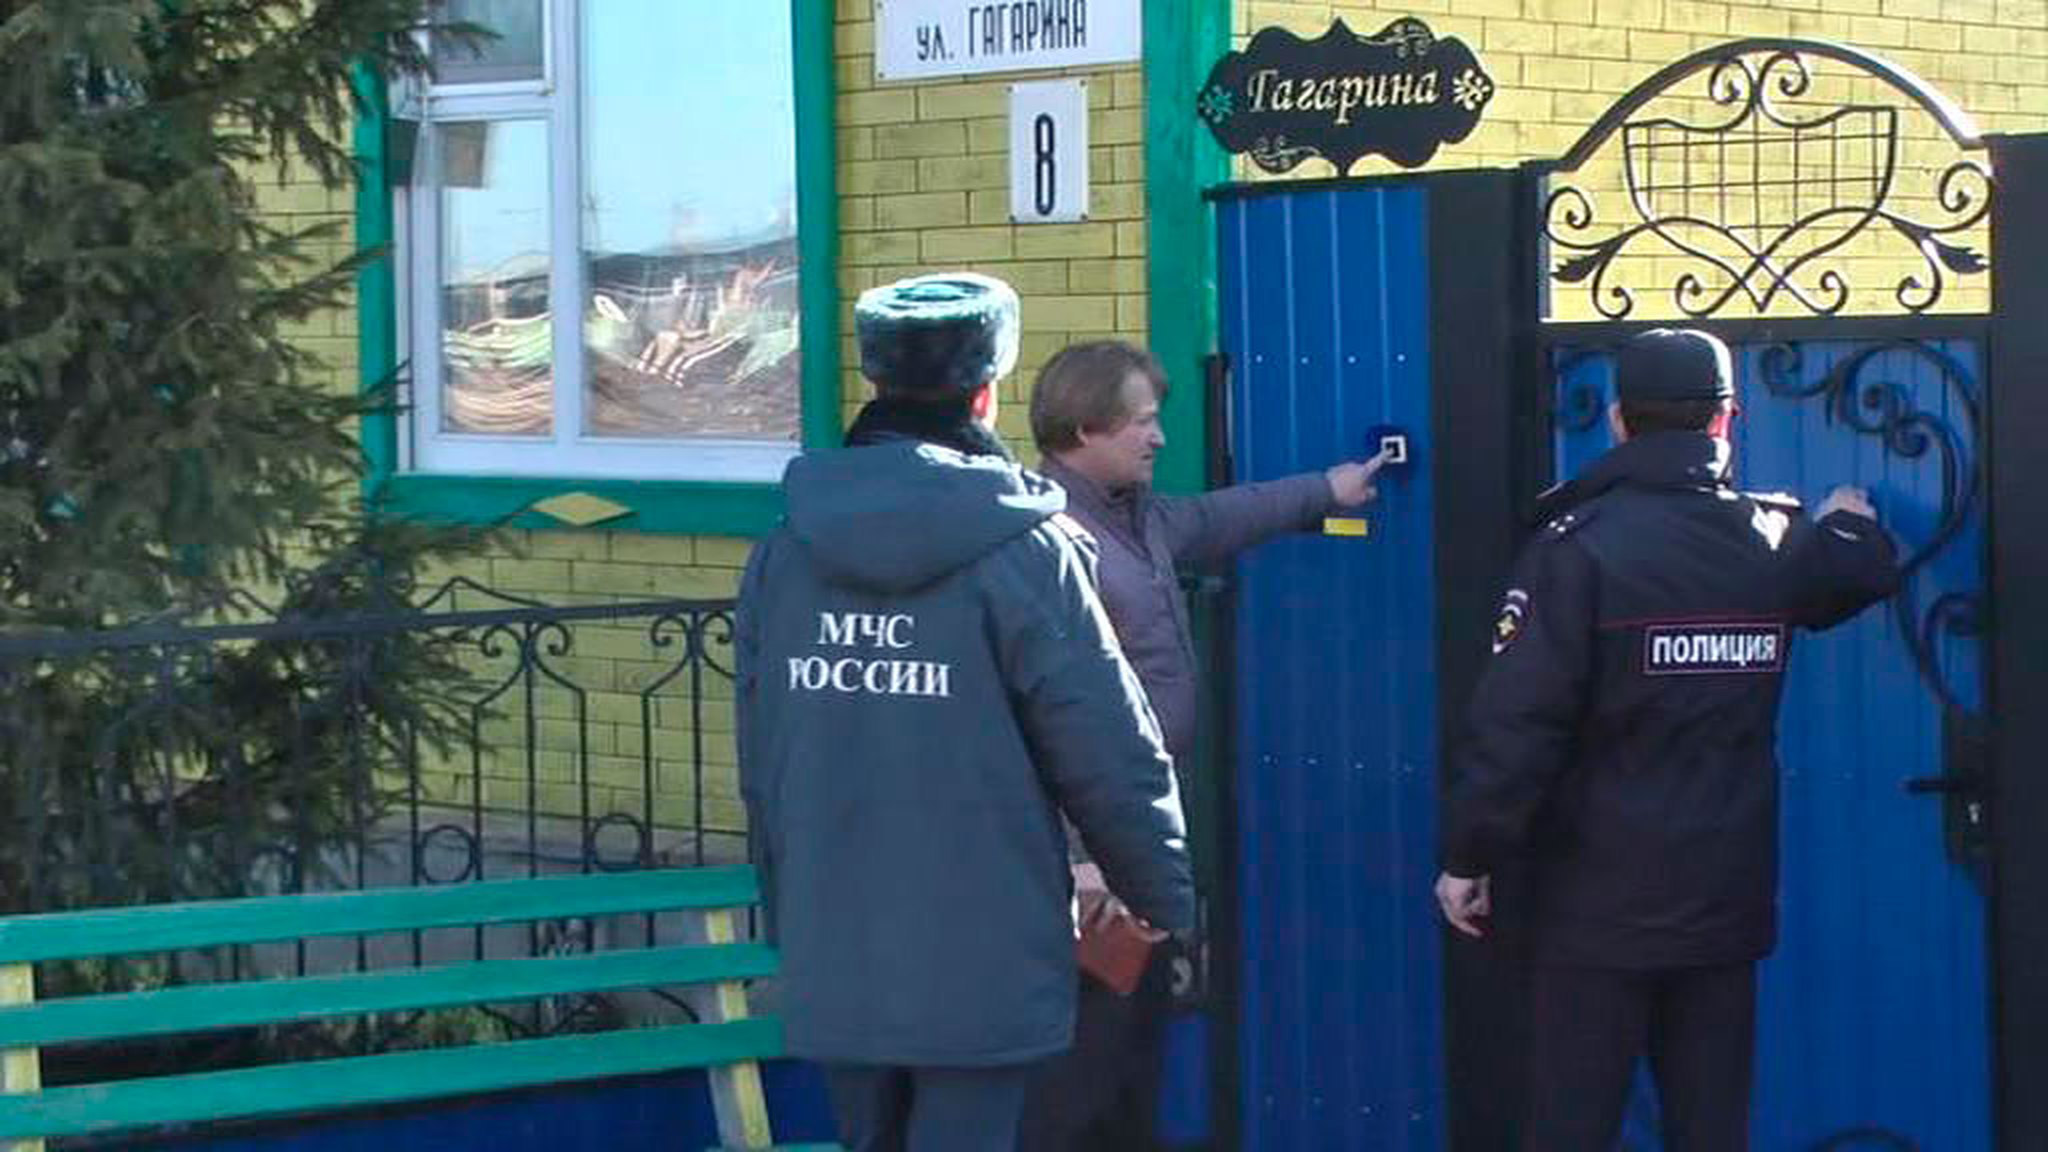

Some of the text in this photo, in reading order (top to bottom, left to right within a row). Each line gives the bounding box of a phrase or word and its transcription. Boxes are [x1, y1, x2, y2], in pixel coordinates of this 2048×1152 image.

[969, 0, 1087, 57] ГАГАРИНА
[1248, 67, 1439, 125] Гагарина
[1034, 113, 1054, 215] 8
[816, 612, 914, 648] МЧС
[1653, 635, 1776, 666] ПОЛИЦИЯ
